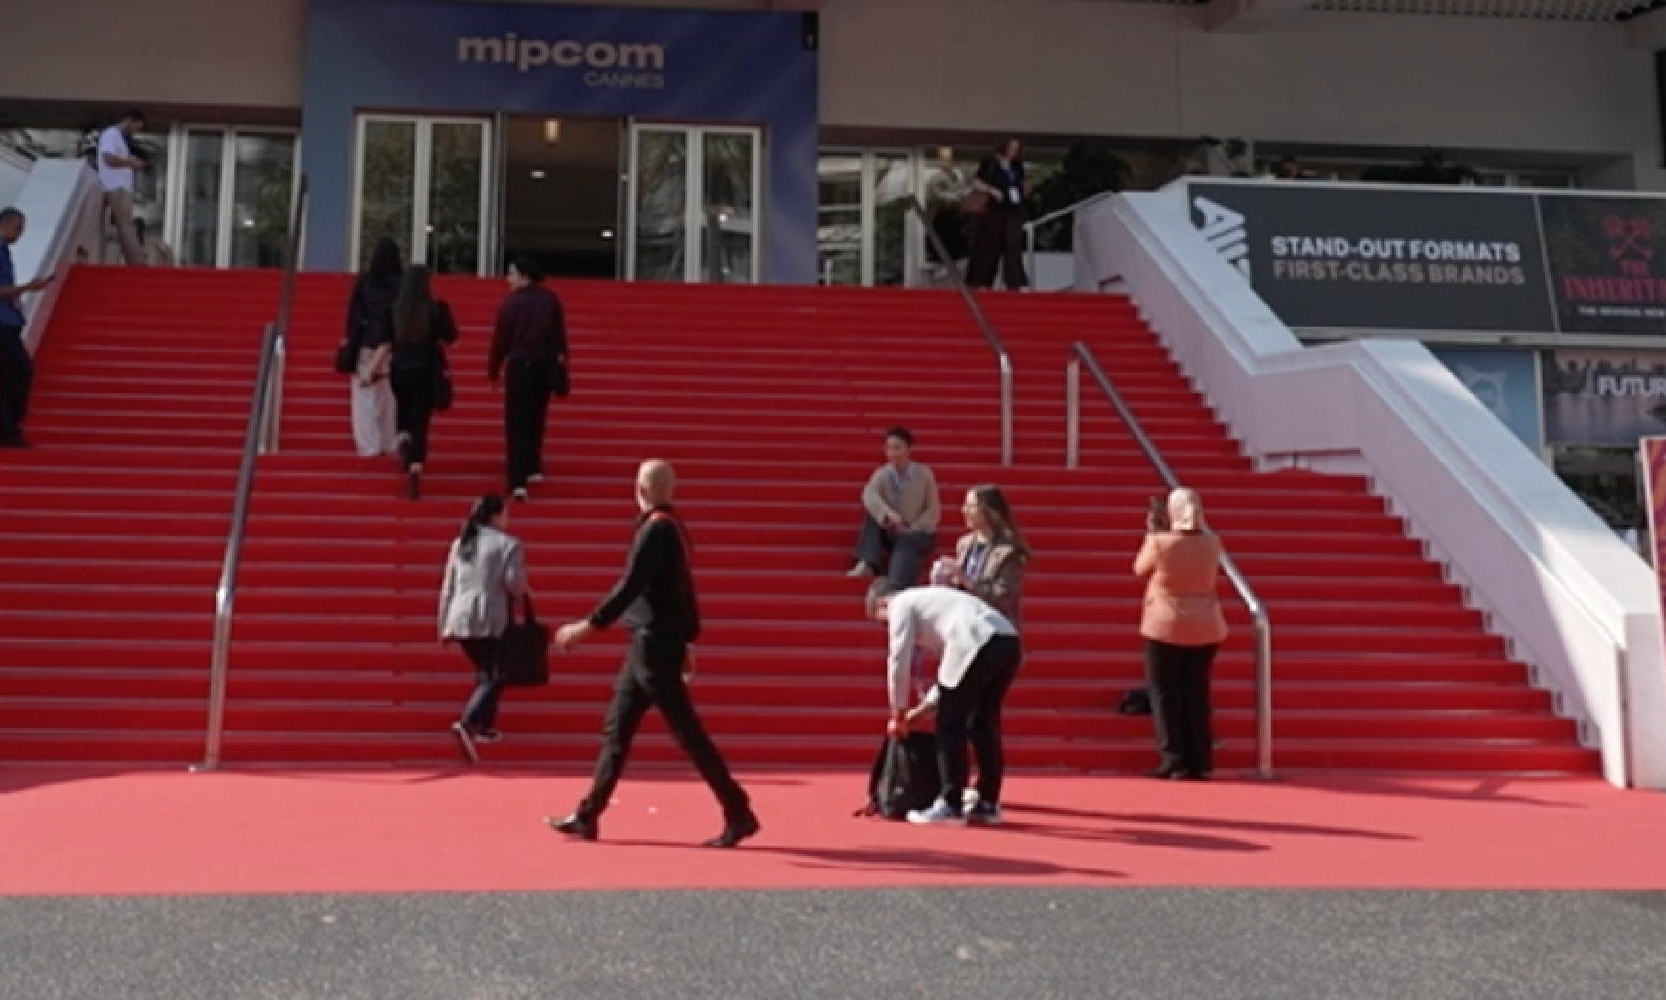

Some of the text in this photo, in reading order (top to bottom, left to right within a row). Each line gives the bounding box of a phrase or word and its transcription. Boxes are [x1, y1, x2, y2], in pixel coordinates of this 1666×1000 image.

[456, 30, 666, 73] mipcom
[583, 71, 666, 90] CANNES
[1271, 235, 1521, 264] STAND-OUT FORMATS
[1273, 260, 1527, 287] FIRST-CLASS BRANDS
